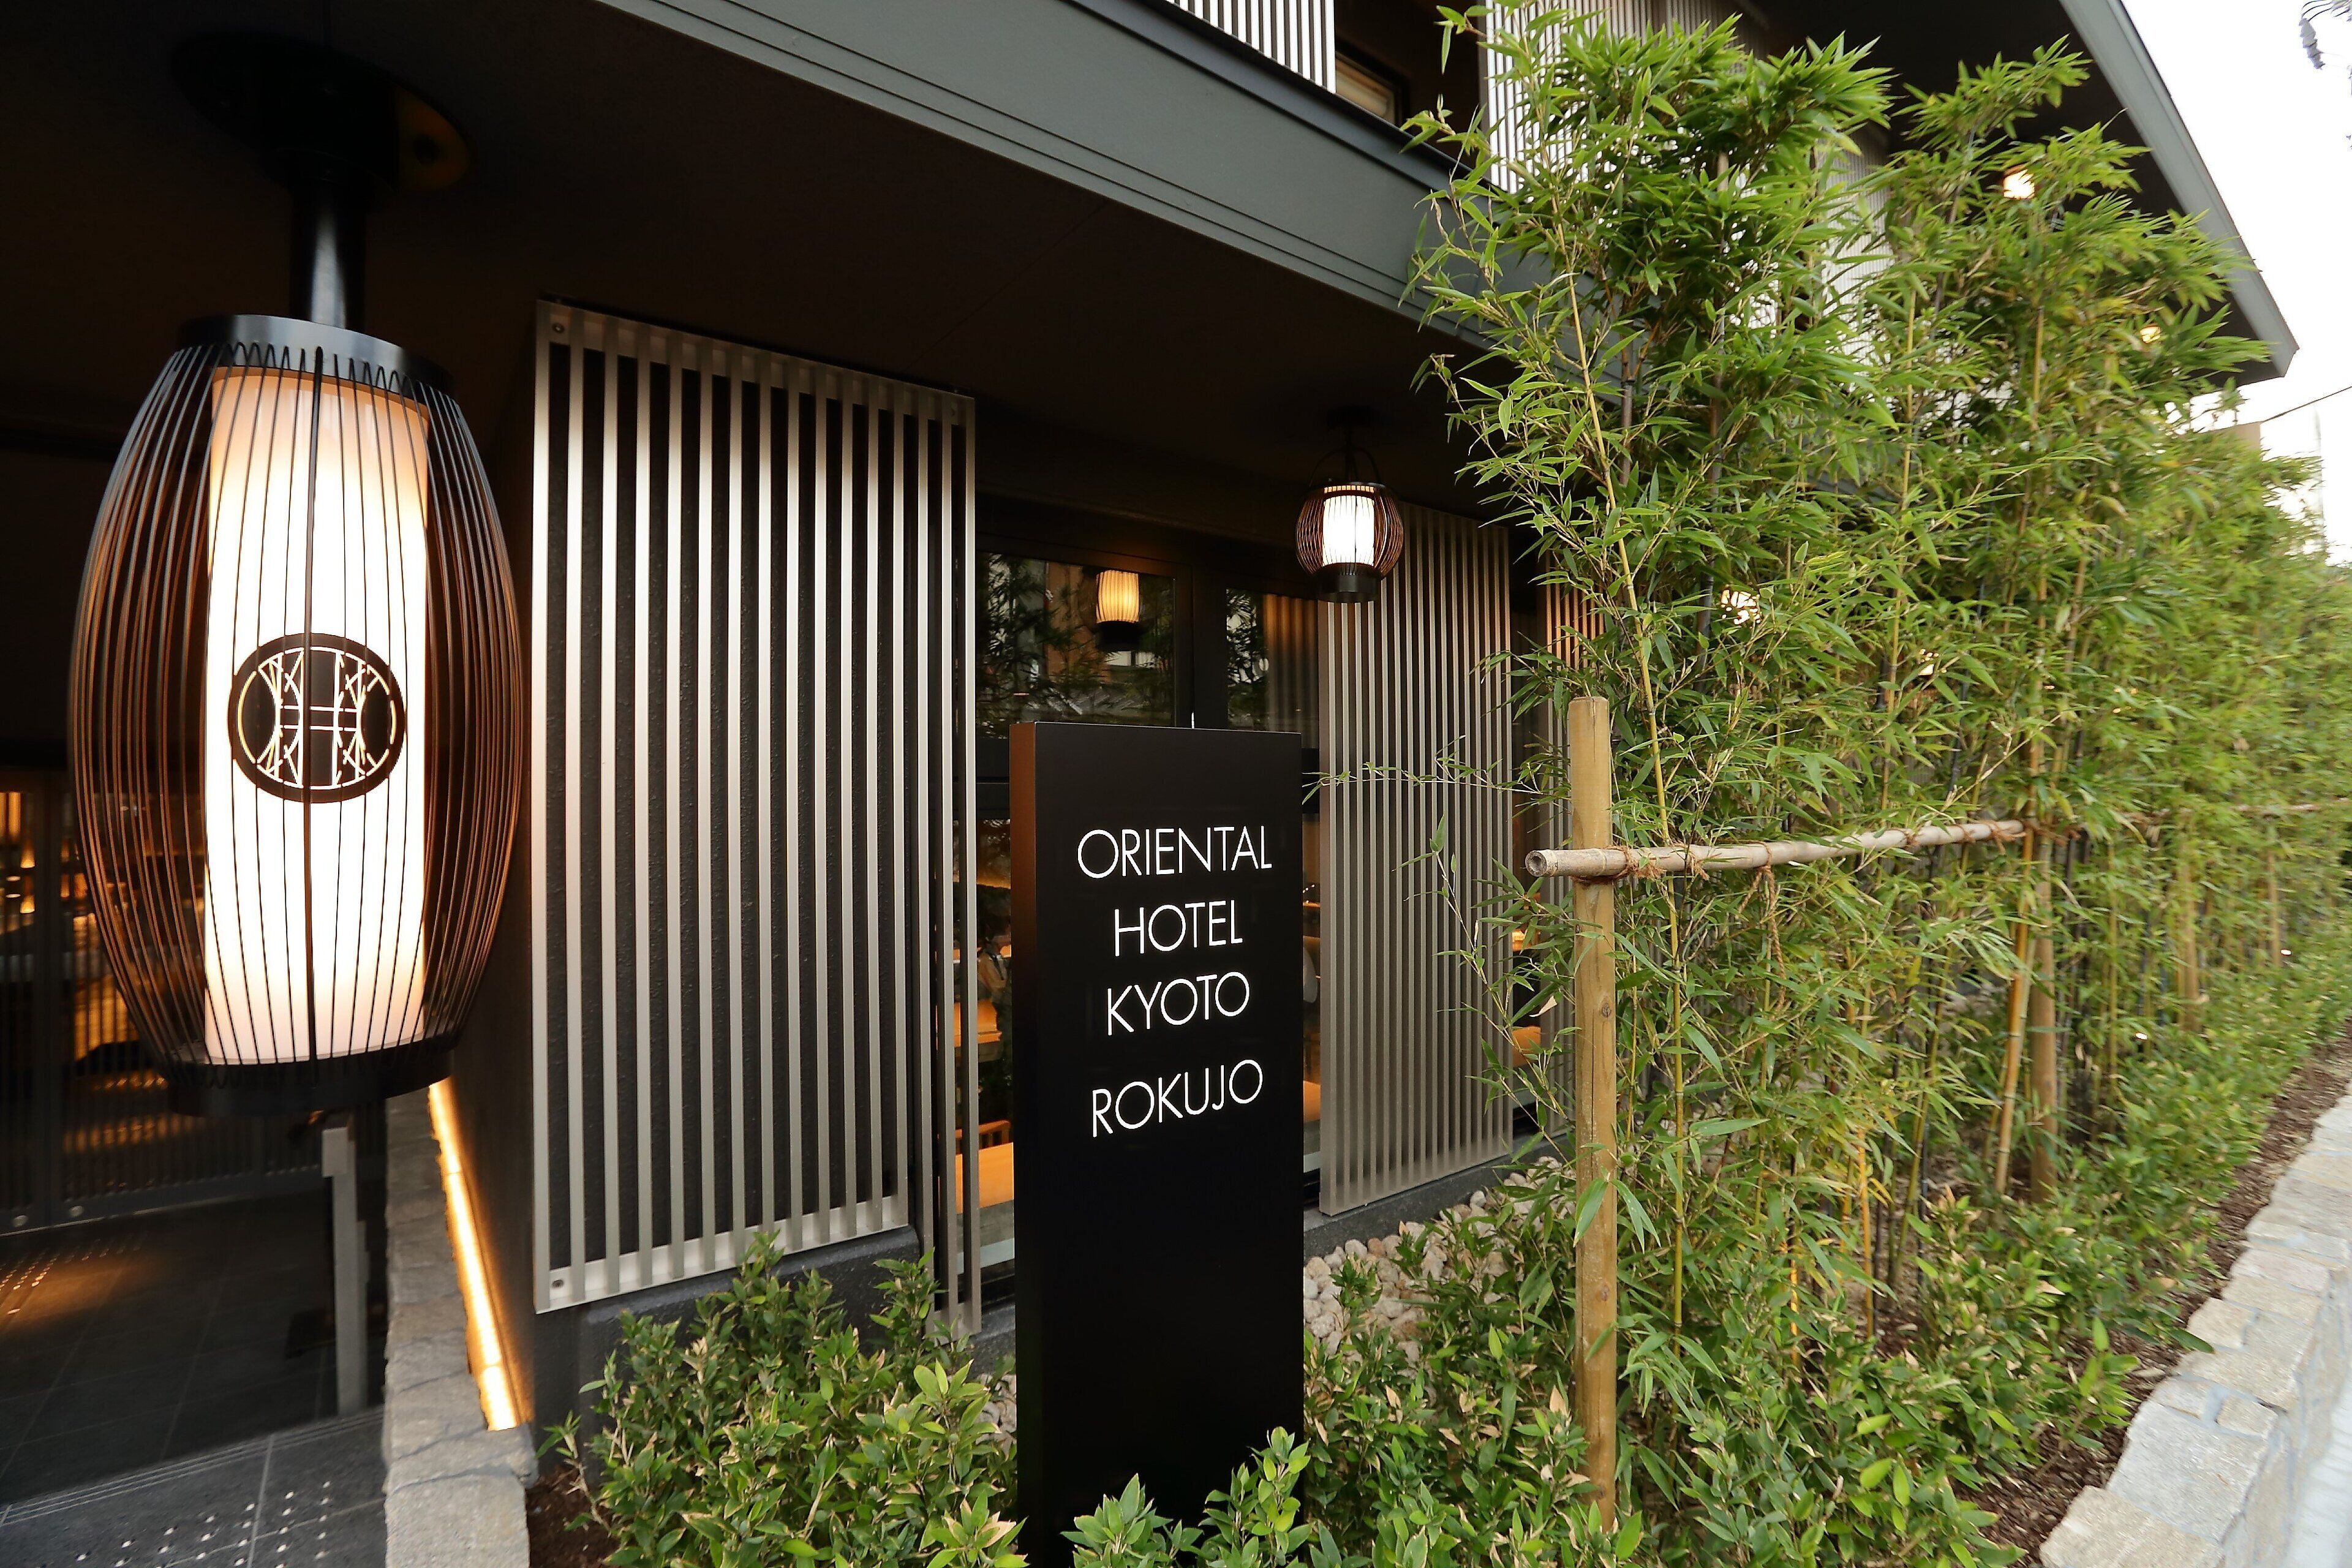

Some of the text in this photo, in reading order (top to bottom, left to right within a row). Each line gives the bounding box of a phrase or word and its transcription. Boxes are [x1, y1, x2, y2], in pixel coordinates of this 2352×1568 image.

[1077, 825, 1272, 879] ORIENTAL
[1114, 900, 1243, 957] HOTEL
[1107, 971, 1250, 1036] KYOTO
[1092, 1059, 1263, 1138] ROKUJO
